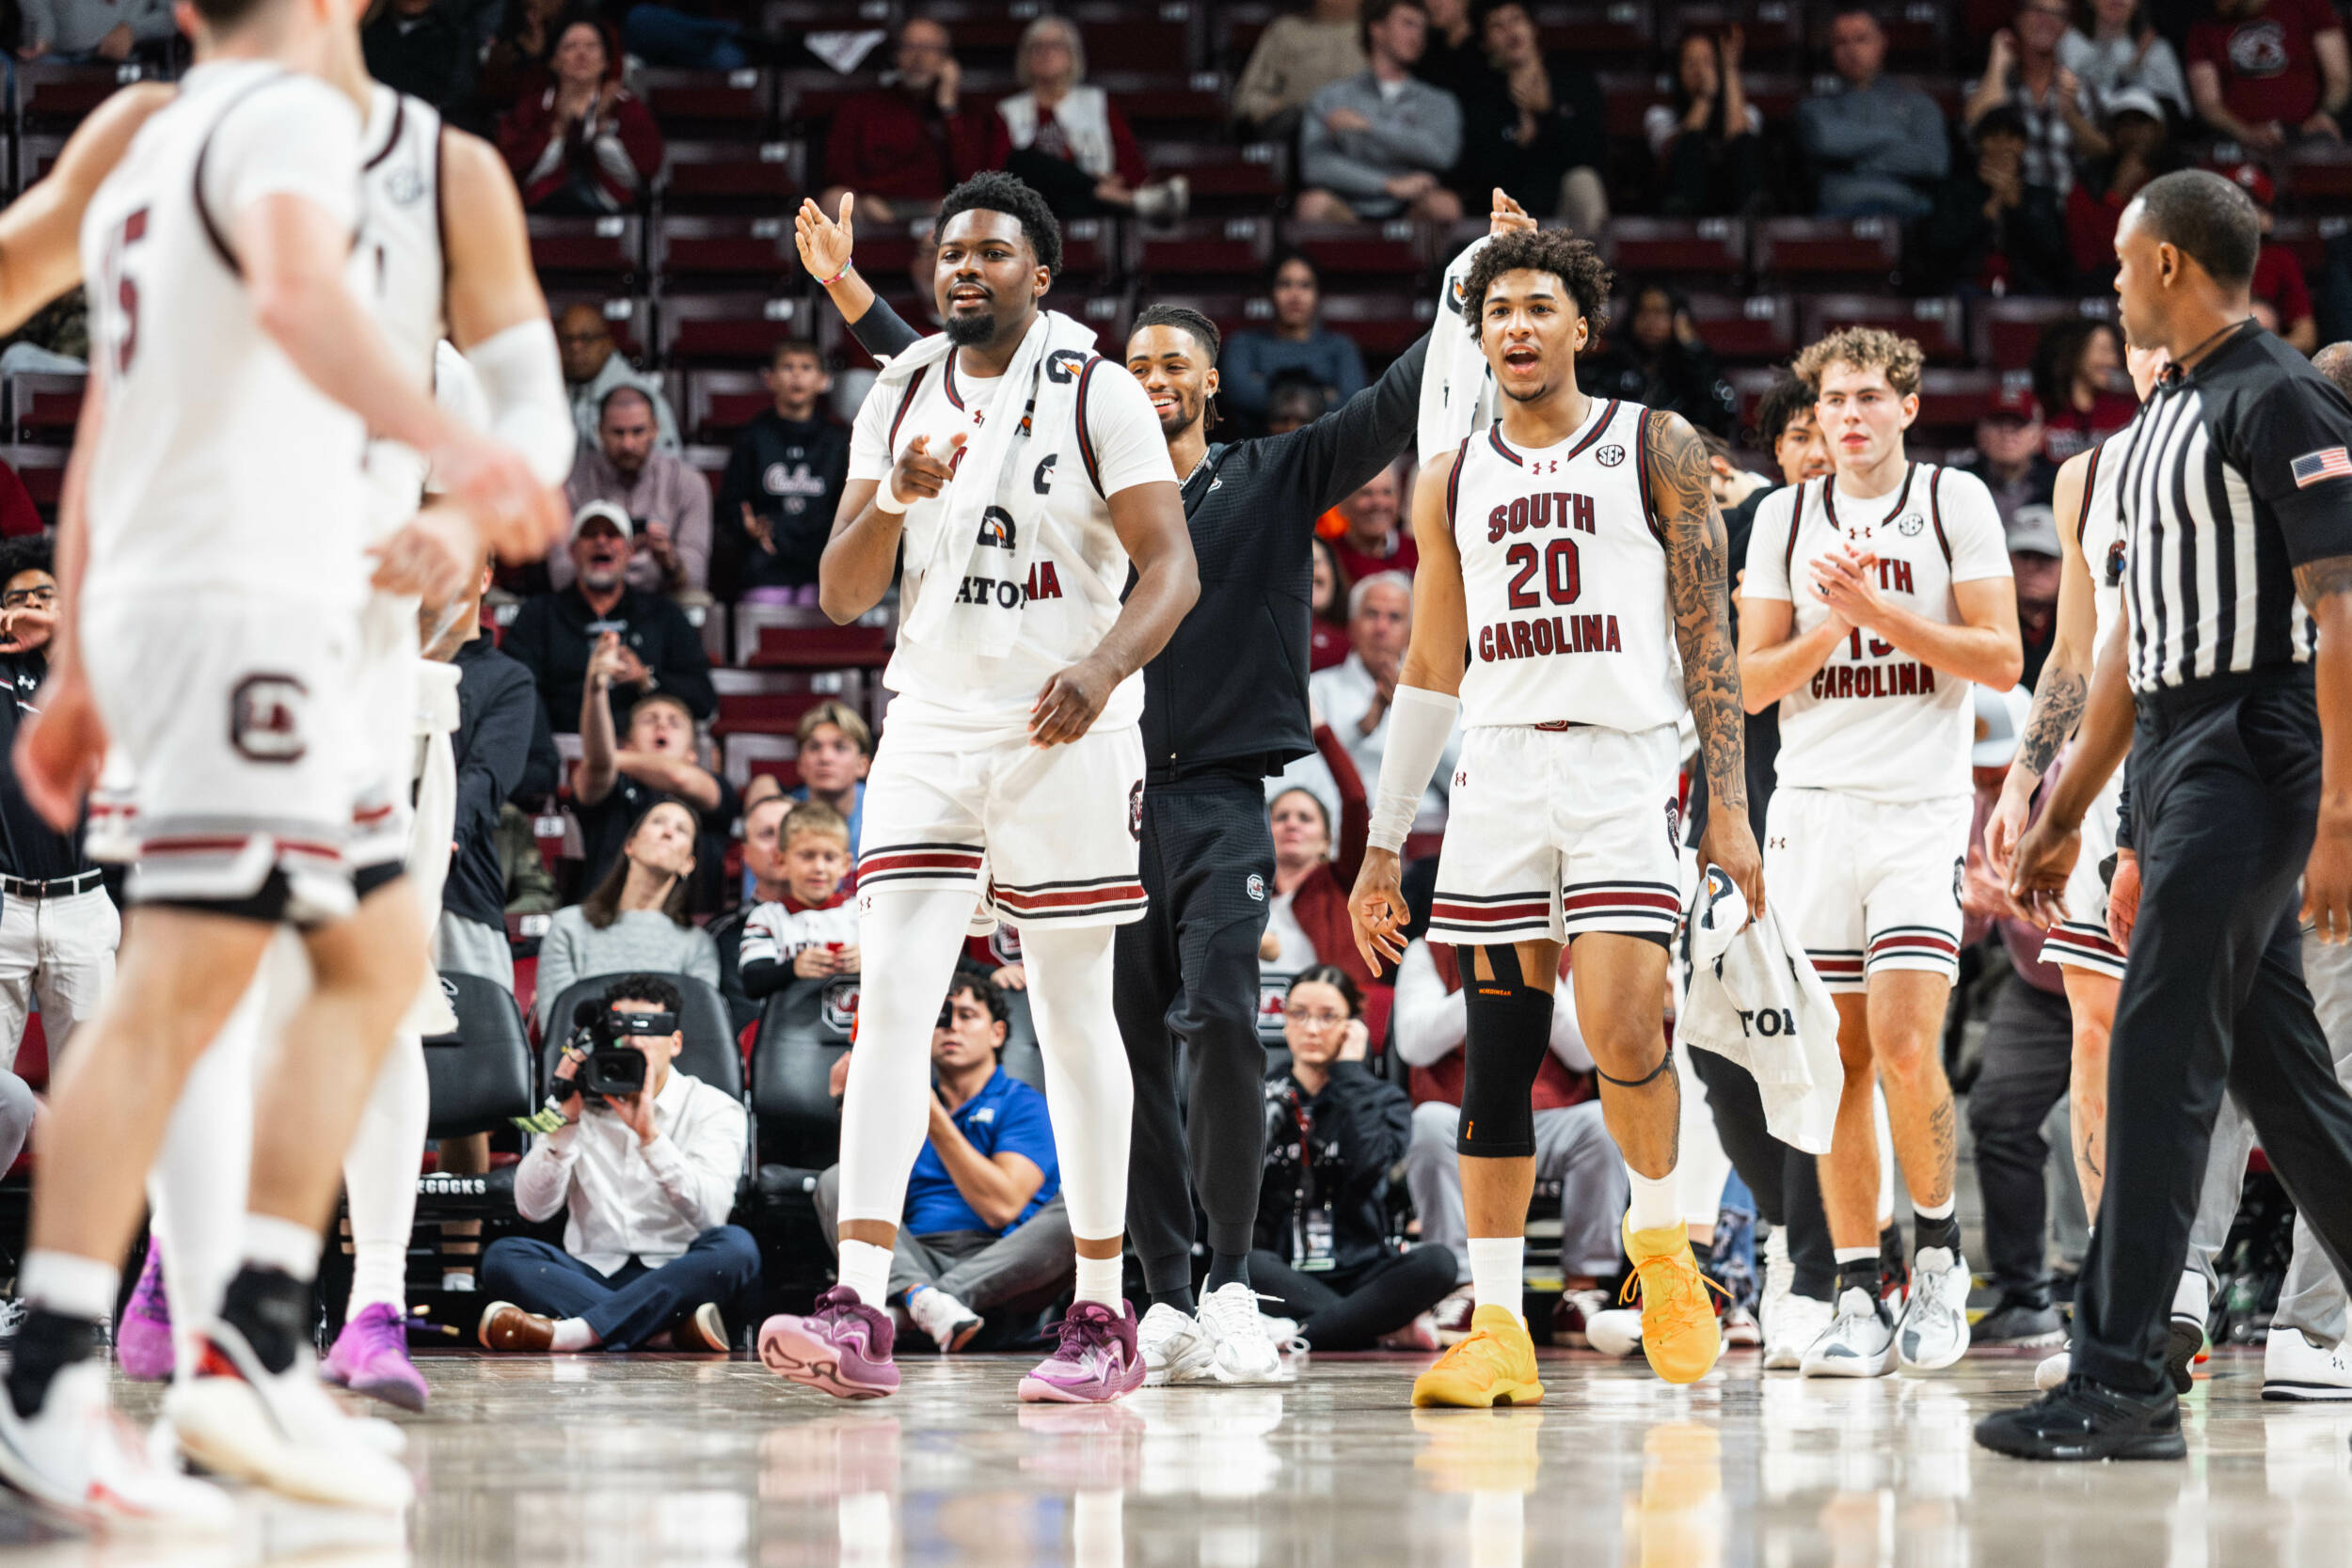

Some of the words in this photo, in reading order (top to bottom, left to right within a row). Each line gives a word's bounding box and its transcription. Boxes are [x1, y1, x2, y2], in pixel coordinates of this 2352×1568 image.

[1597, 445, 1625, 467] SEC
[1488, 492, 1596, 544] SOUTH
[1506, 538, 1581, 610] 20
[1479, 614, 1622, 662] CAROLINA
[1811, 662, 1935, 700] CAROLINA
[416, 1179, 486, 1195] ECOCKS
